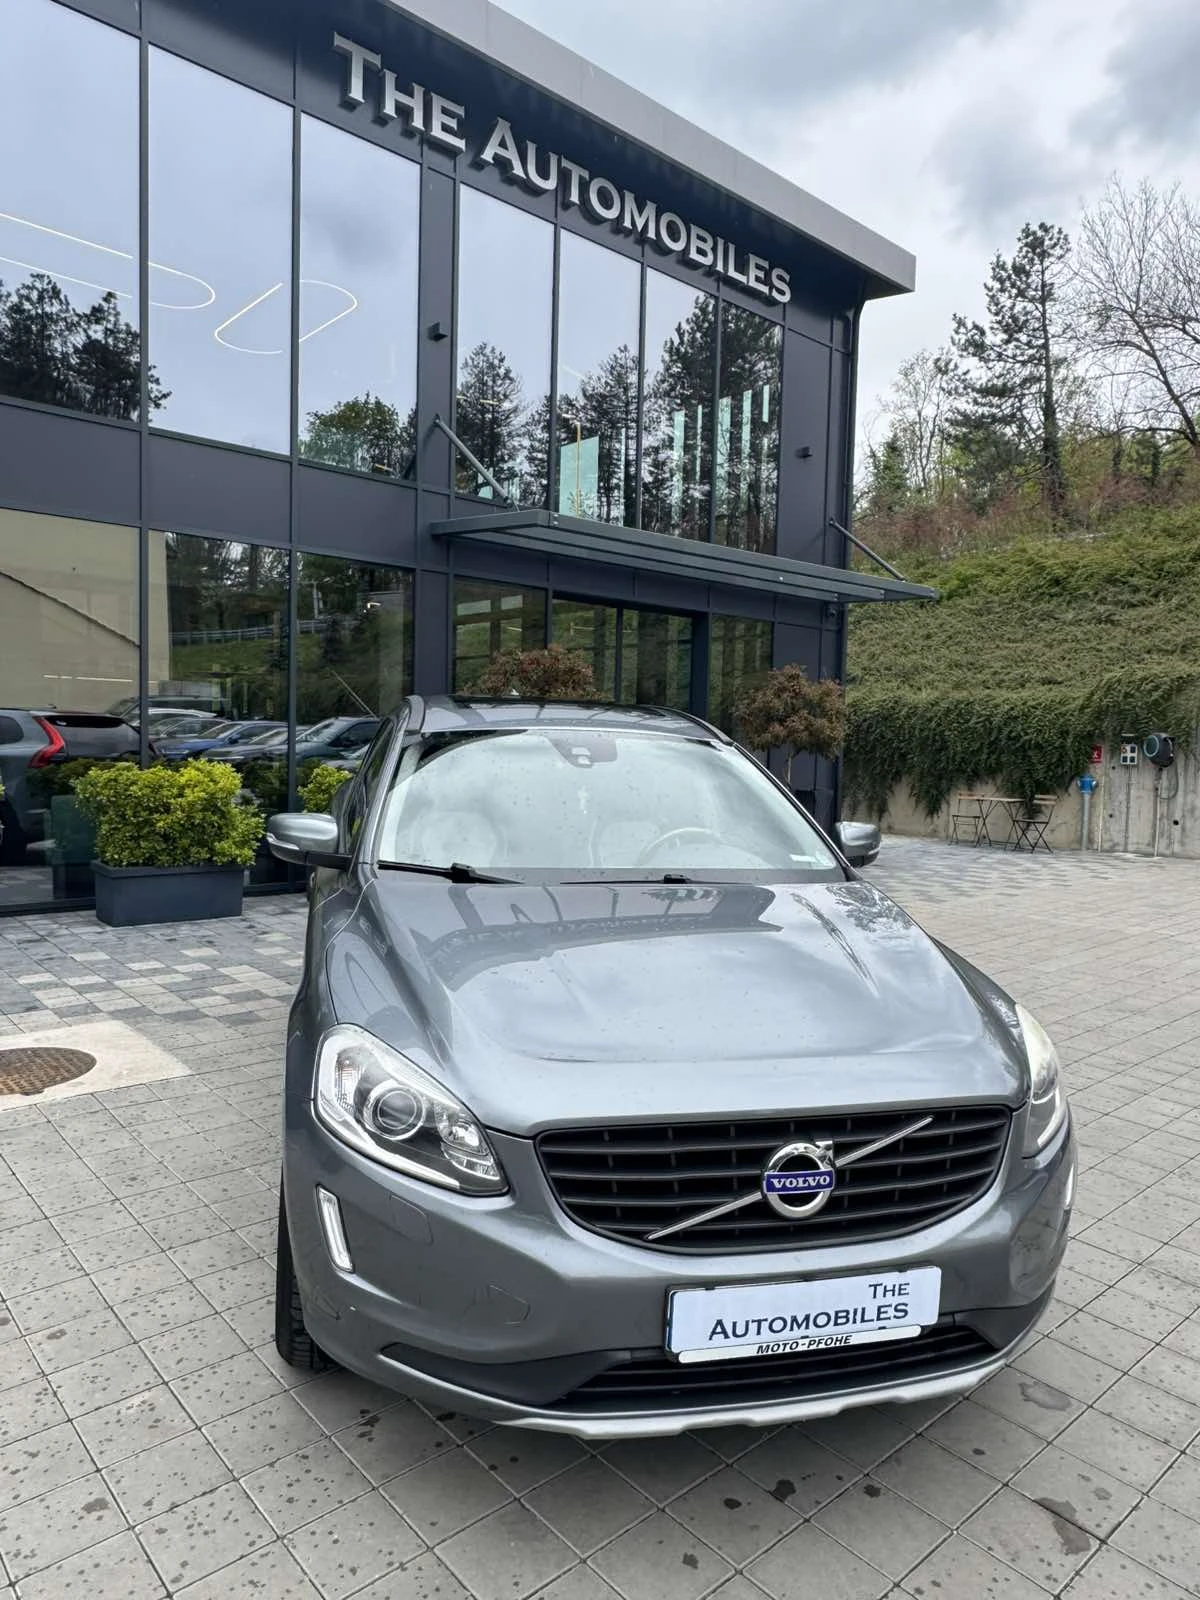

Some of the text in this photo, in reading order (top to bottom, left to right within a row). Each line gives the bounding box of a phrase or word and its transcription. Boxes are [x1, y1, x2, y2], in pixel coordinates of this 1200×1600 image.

[333, 32, 792, 304] THE AUTOMOBILES
[770, 1174, 831, 1189] VOLVO
[868, 1281, 911, 1300] THE
[708, 1302, 910, 1341] AUTOMOBILES
[756, 1334, 853, 1355] MOTO-PFOHE
